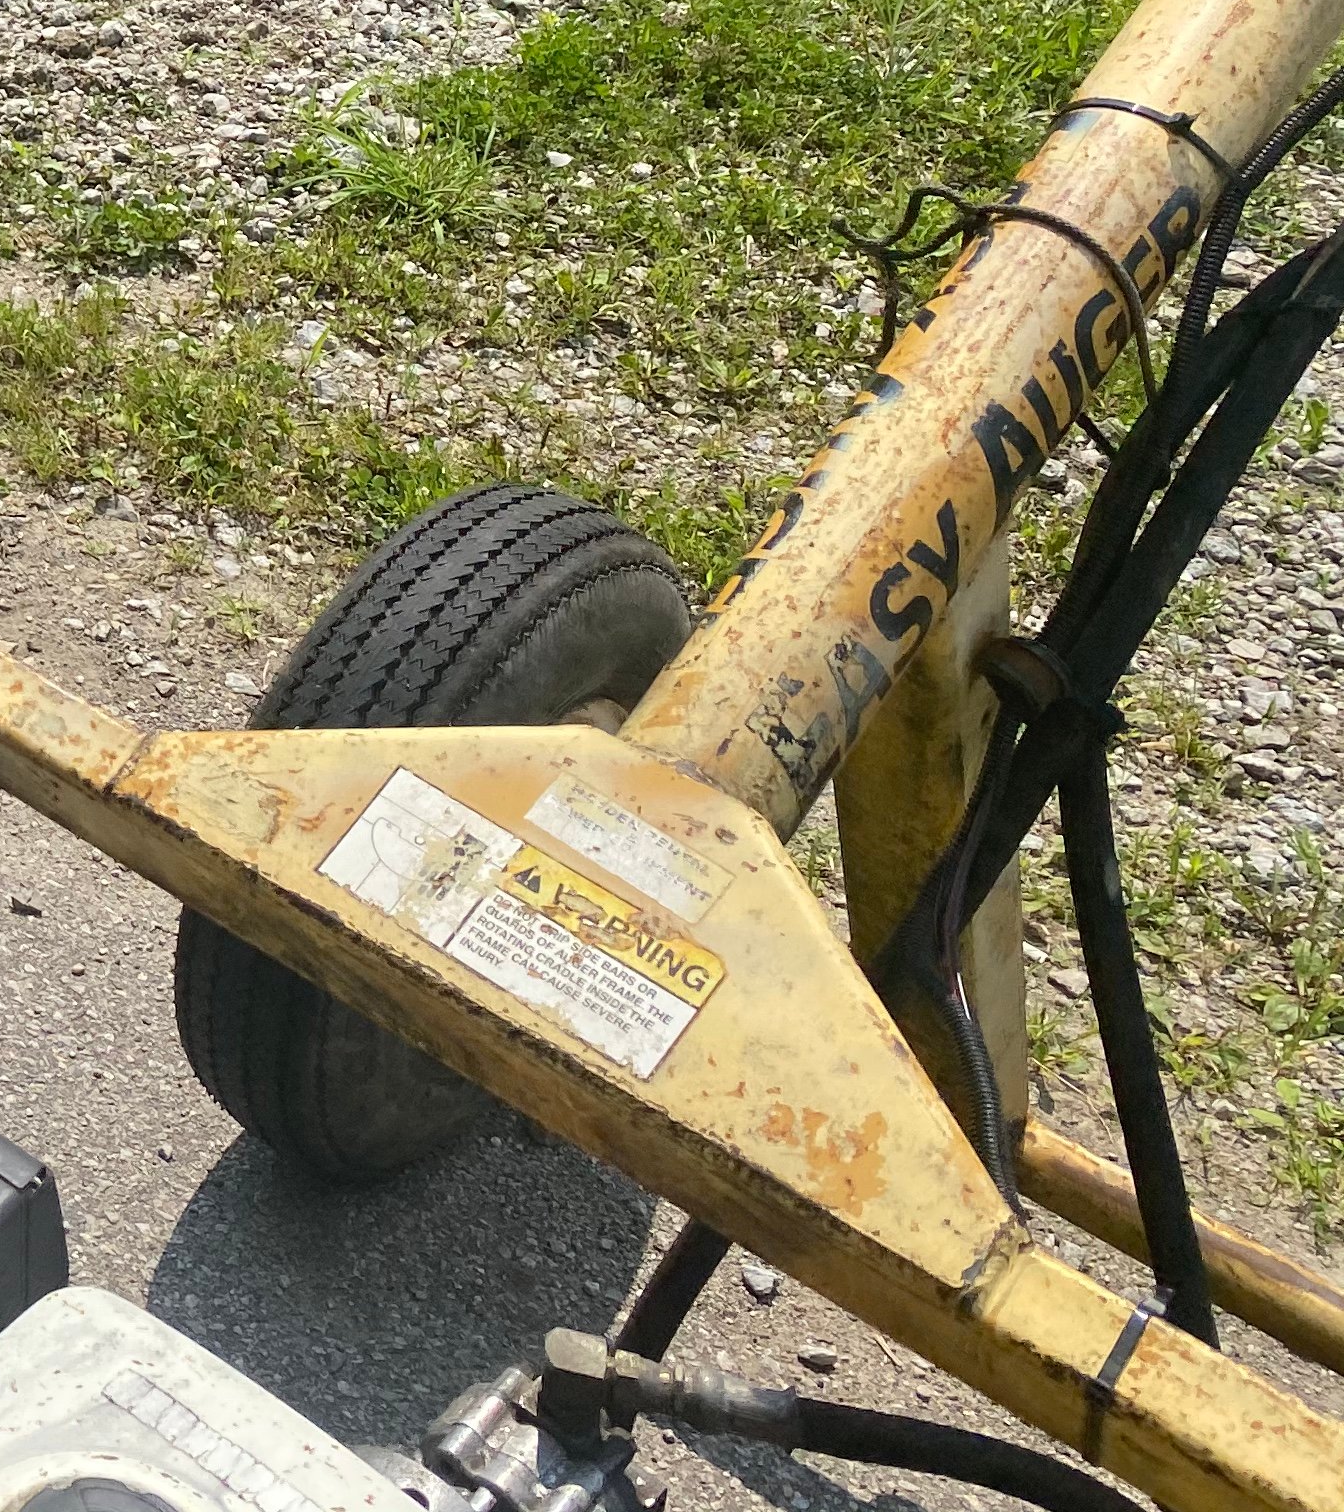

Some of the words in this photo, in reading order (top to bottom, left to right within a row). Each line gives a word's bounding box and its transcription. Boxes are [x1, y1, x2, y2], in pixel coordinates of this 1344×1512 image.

[467, 925, 511, 956] FRAME
[509, 952, 538, 974] CAN
[537, 969, 582, 1001] CAUSE
[580, 996, 633, 1033] SEVERE
[475, 914, 536, 956] ROTATING
[534, 951, 588, 988] CRADLE
[585, 983, 629, 1014] INSIDE
[625, 1008, 655, 1031] THE
[483, 903, 537, 940] GUARDS
[534, 935, 556, 953] OF
[554, 947, 600, 980] AUGER
[645, 1004, 673, 1026] THE
[512, 904, 540, 926] NOT
[569, 940, 601, 964] SIDE
[599, 959, 638, 988] BARS
[636, 982, 658, 1000] OR
[552, 883, 711, 993] RNING
